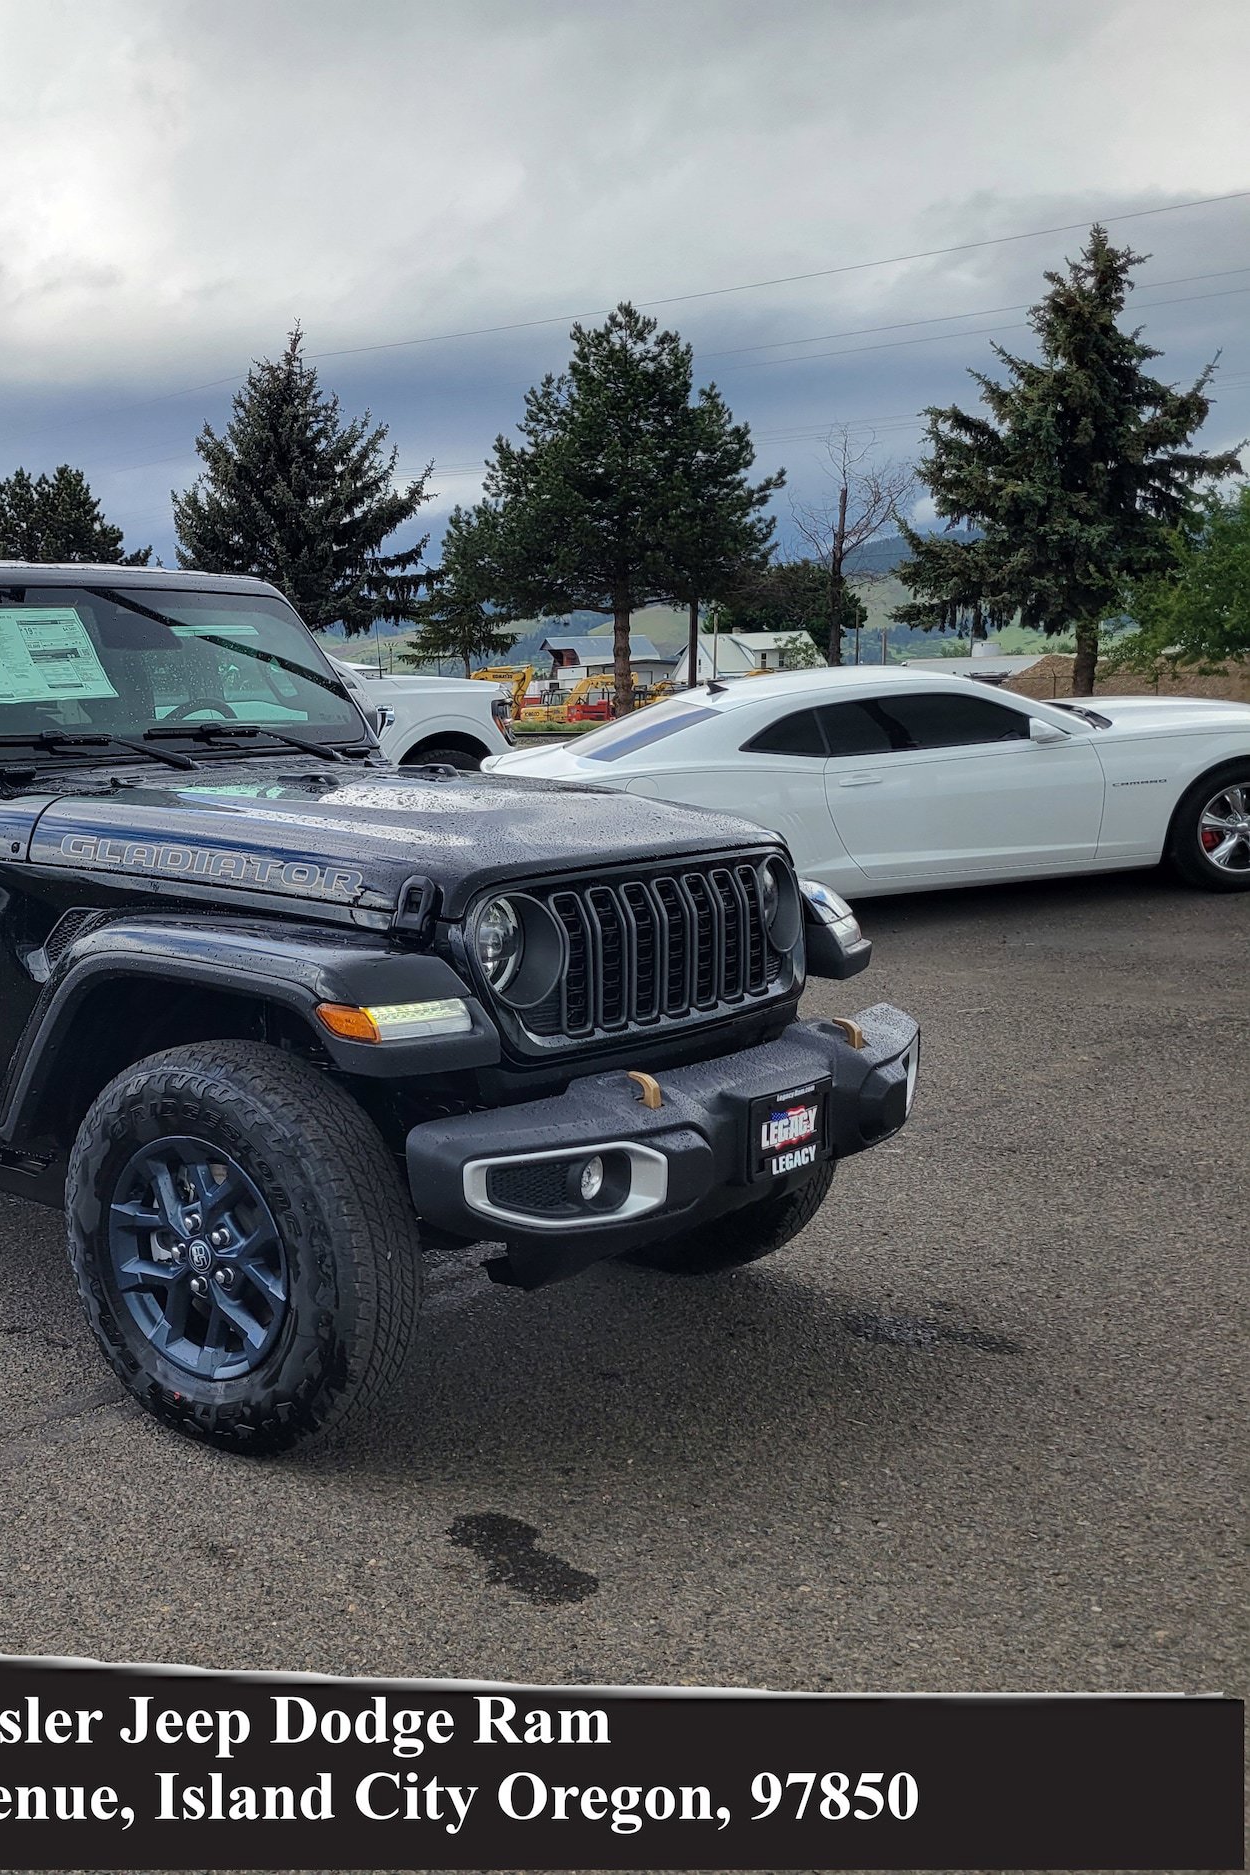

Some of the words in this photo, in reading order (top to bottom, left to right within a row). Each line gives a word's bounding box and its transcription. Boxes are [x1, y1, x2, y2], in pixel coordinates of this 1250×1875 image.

[1112, 779, 1167, 787] CAMARO
[60, 833, 364, 897] GLADIATOR
[761, 1107, 818, 1148] LEGACY
[772, 1145, 816, 1175] LEGACY
